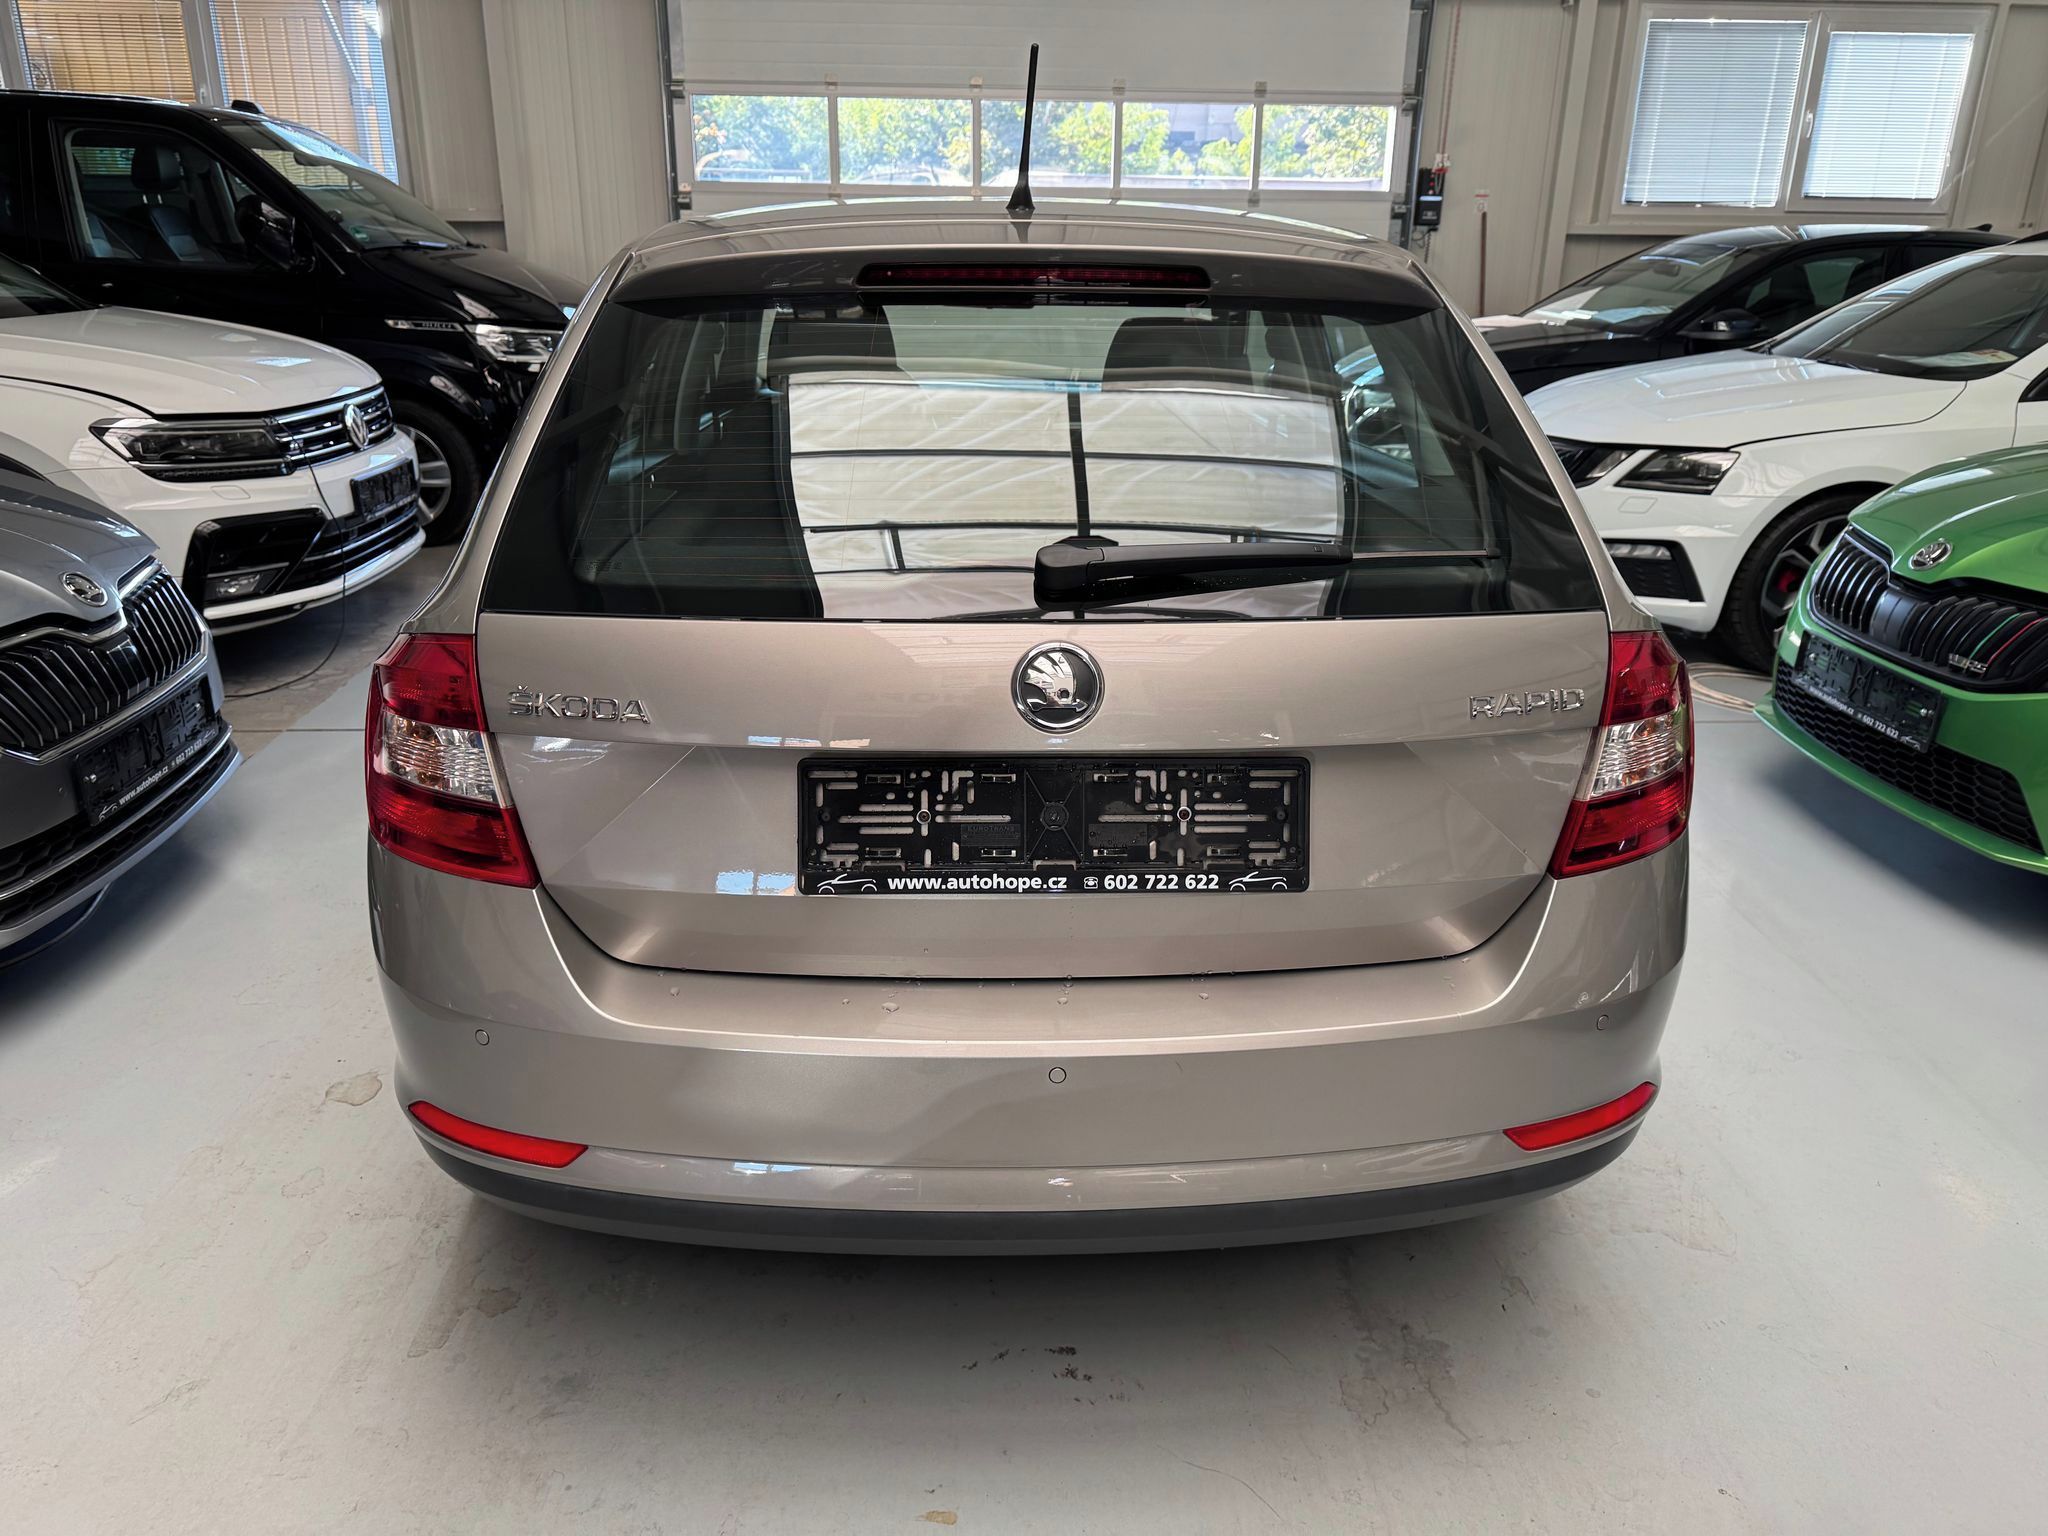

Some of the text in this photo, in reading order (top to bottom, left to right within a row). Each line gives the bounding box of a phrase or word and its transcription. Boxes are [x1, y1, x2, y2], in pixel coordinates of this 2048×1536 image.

[508, 684, 651, 724] ŠKODA
[1469, 688, 1585, 719] RAPID
[1809, 685, 1899, 739] www.autohope.cz 602 722 622
[118, 765, 169, 805] www.autohope.cz
[175, 753, 185, 765] 602
[185, 746, 194, 758] 722
[887, 873, 1219, 893] www.autohope.cz 602 722 622
